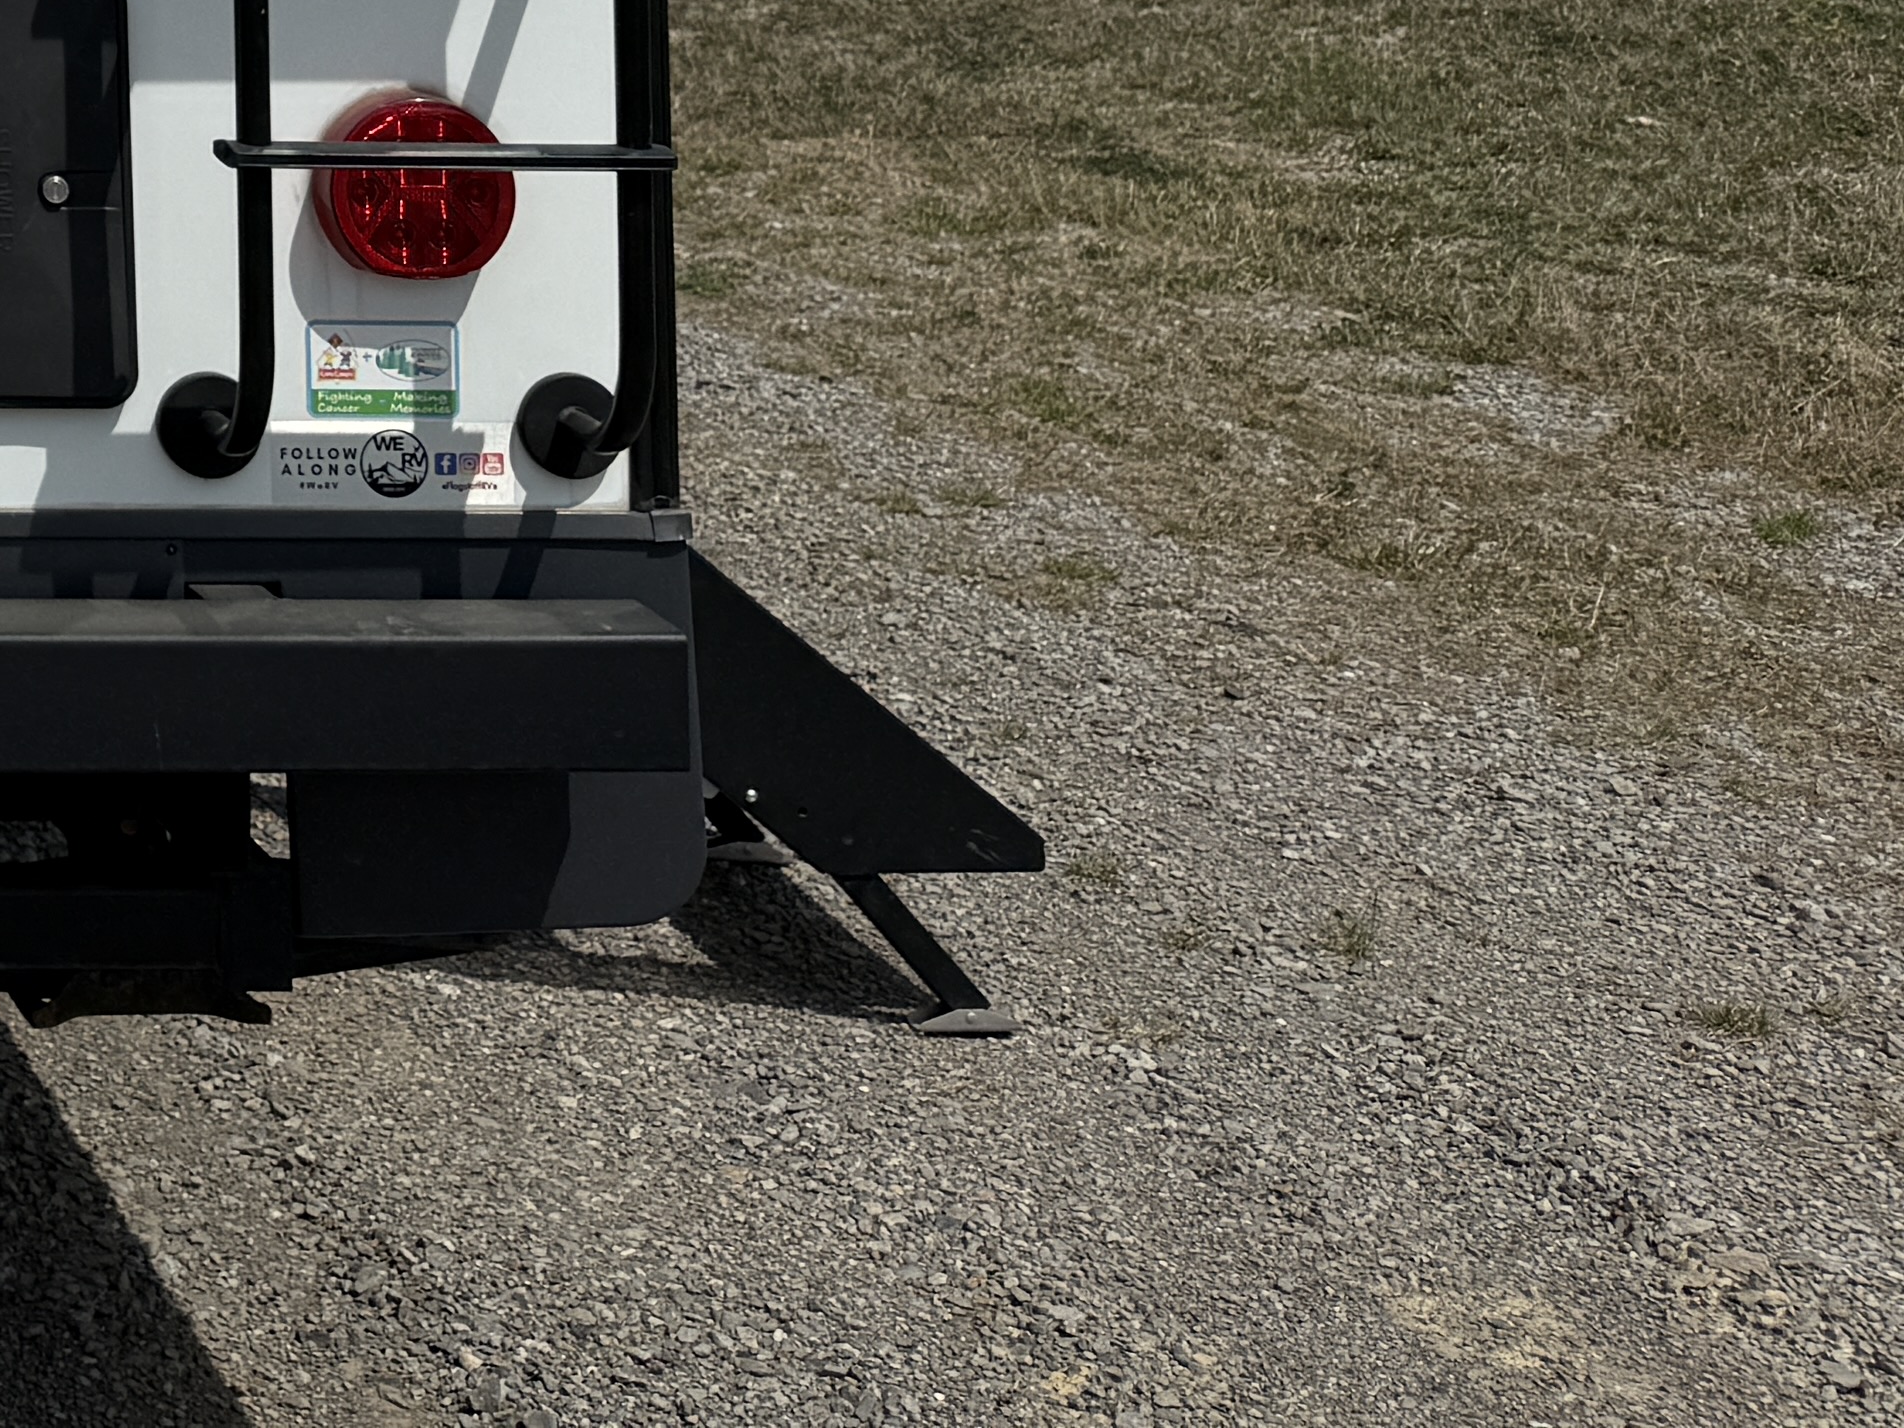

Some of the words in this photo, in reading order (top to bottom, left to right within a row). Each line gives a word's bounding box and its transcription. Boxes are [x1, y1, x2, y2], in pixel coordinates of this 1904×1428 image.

[317, 391, 372, 403] Fighting
[393, 392, 448, 403] Making
[317, 403, 360, 413] Cancer
[390, 403, 451, 414] Memories
[373, 436, 405, 451] WE
[280, 447, 358, 460] FOLLOW
[402, 453, 425, 467] RV
[281, 463, 357, 476] ALONG
